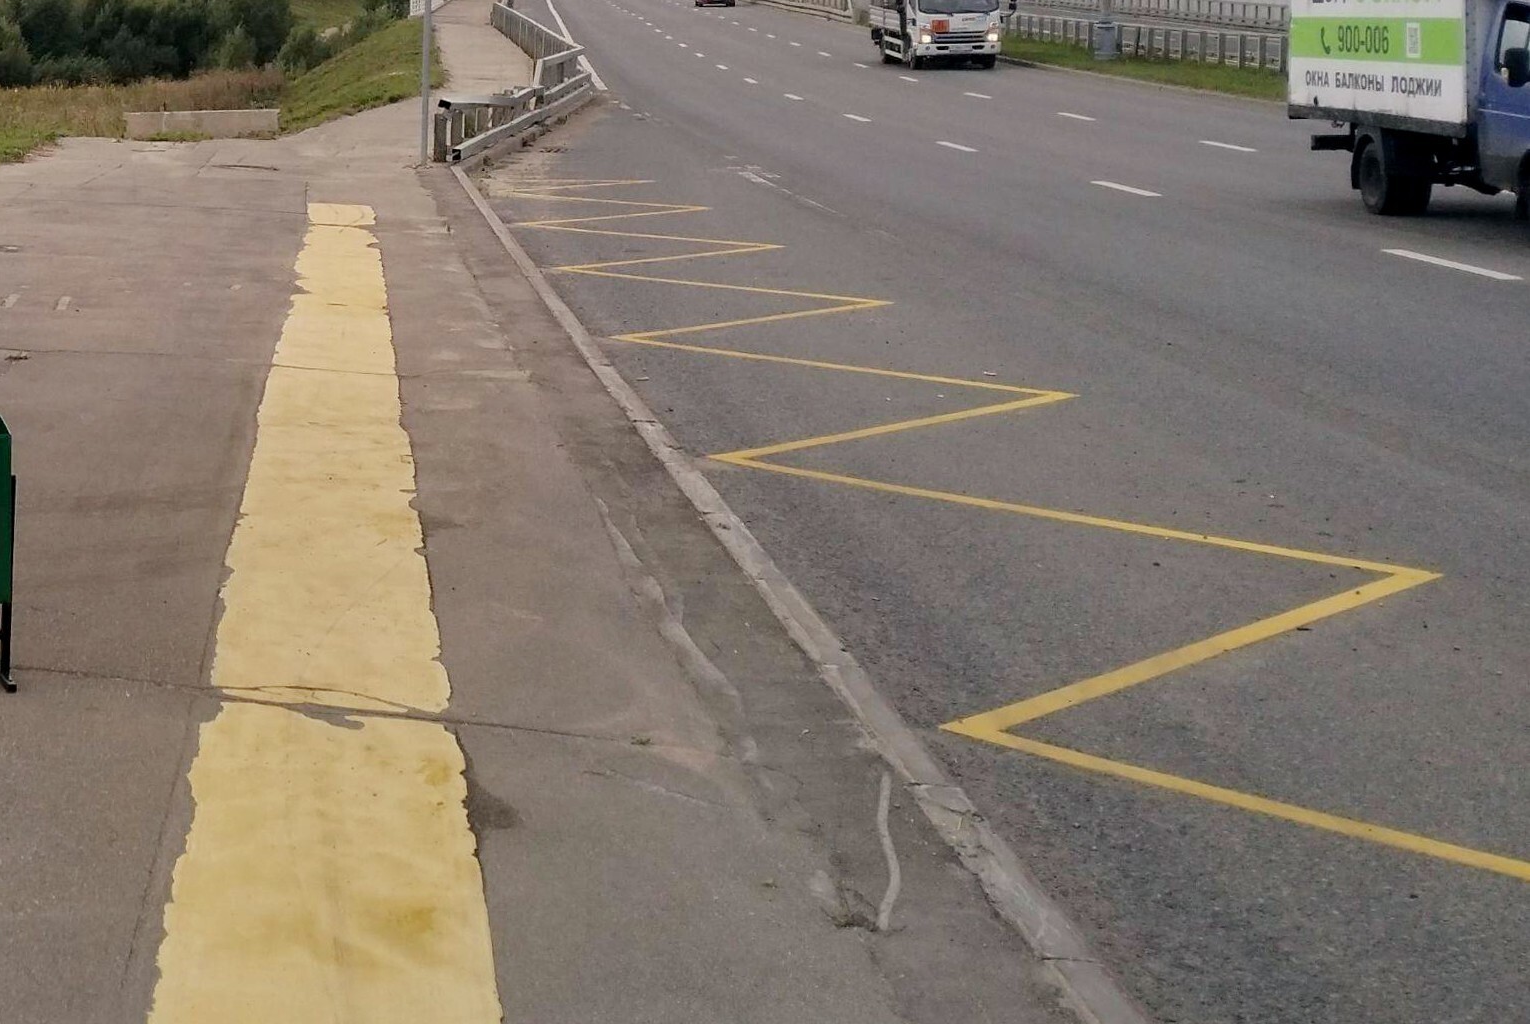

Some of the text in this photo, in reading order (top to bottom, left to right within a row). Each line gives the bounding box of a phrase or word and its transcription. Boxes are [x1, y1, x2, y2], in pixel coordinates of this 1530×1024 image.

[1337, 25, 1389, 54] 900-006
[1305, 70, 1442, 98] ОКНА БАЛКОНЫ ЛОДЖИИ
